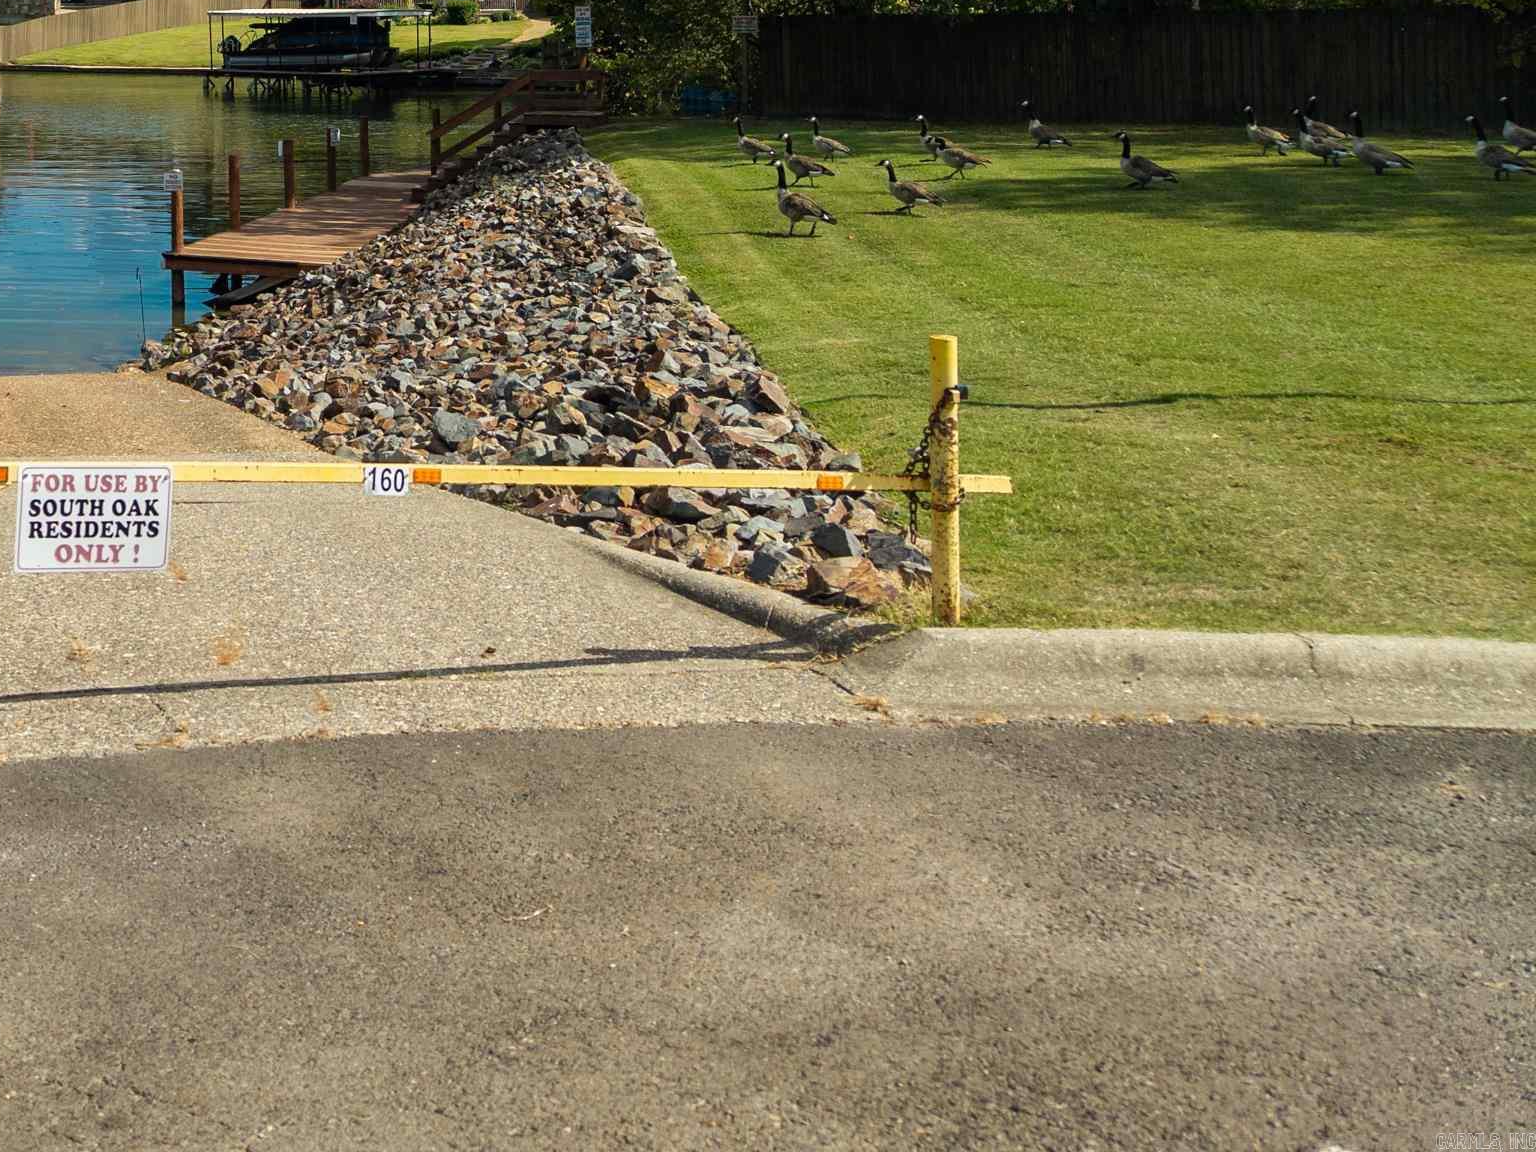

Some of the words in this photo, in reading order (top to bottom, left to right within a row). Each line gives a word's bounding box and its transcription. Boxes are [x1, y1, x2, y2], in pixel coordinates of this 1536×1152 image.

[31, 474, 75, 492] FOR
[84, 475, 128, 492] USE
[134, 475, 162, 493] BY
[368, 467, 404, 492] 160
[28, 499, 104, 517] SOUTH
[112, 499, 160, 517] OAK
[28, 521, 160, 538] RESIDENTS
[54, 544, 125, 563] ONLY
